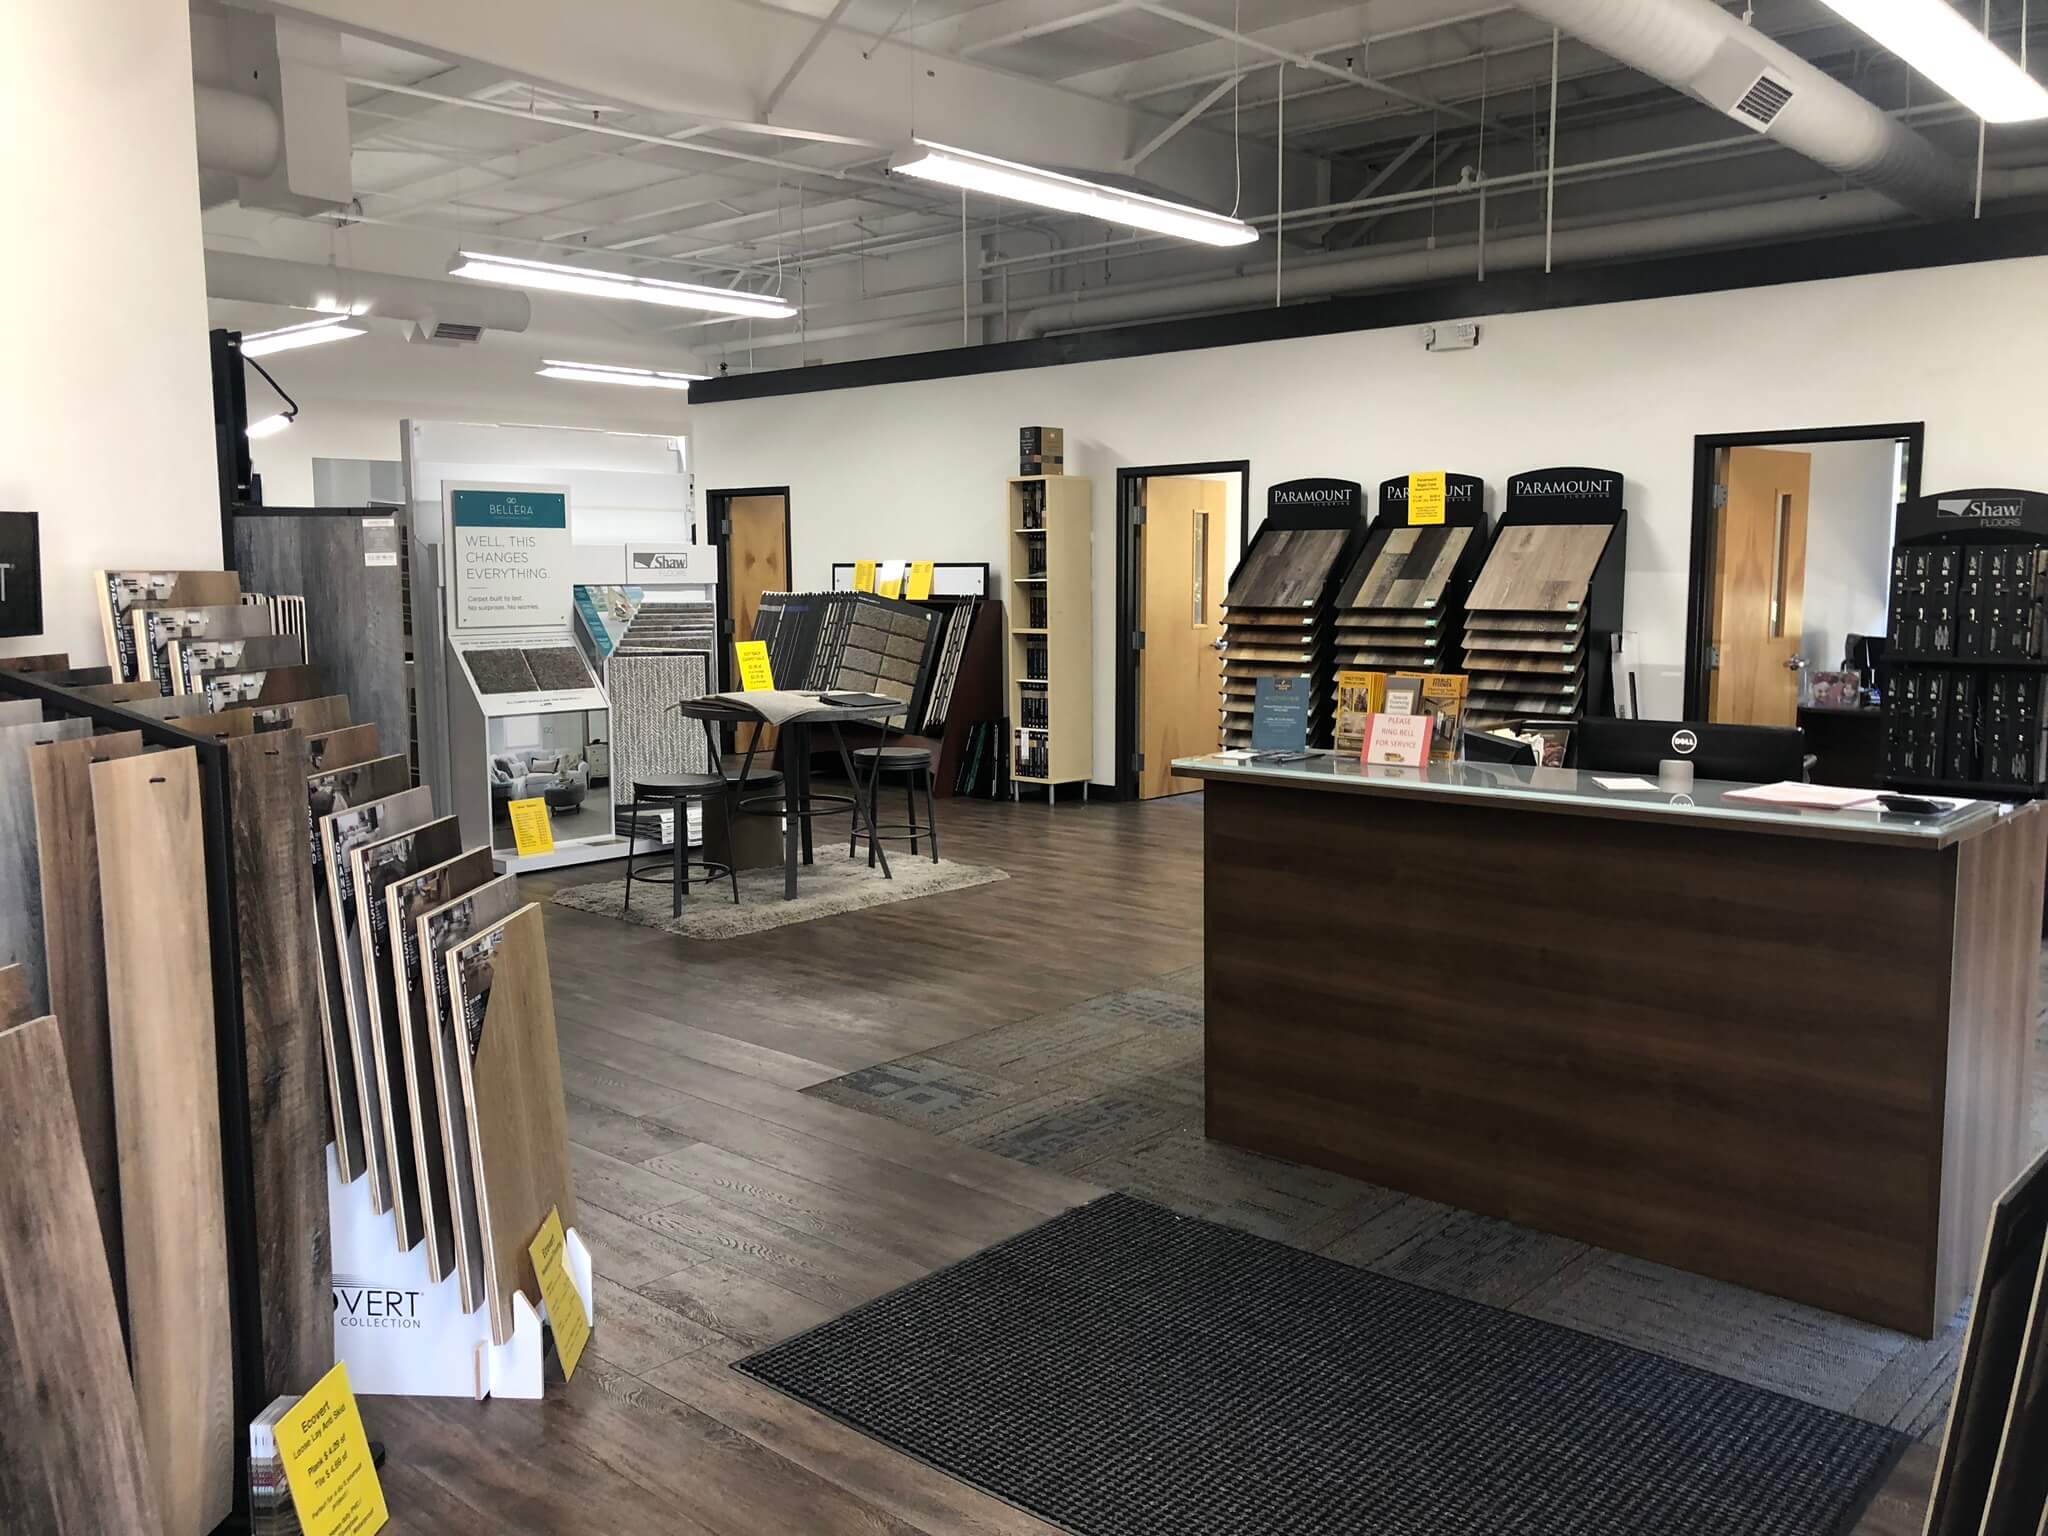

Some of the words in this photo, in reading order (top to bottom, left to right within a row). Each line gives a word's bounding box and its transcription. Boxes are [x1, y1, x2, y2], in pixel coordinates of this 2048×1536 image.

[1387, 484, 1474, 499] PARUNT
[1516, 479, 1613, 495] PARAMOUNT
[1274, 489, 1353, 503] PARAMOUNT
[489, 504, 534, 515] BELLERA
[1969, 501, 2020, 517] Shaw
[465, 535, 505, 549] WELL,
[509, 535, 536, 548] THIS
[465, 552, 529, 563] CHANGES
[654, 555, 686, 569] Shaw
[109, 580, 130, 677] SPLENDOR
[1388, 716, 1411, 725] PLEASE
[1381, 728, 1398, 736] RING
[1399, 729, 1414, 737] BELL
[1375, 740, 1389, 748] FOR
[1390, 741, 1416, 749] SERVICE
[1674, 737, 1694, 746] DELL
[335, 842, 347, 900] GRAND
[364, 862, 381, 957] MAJESTIC
[398, 896, 413, 992] MAJESTIC
[341, 1317, 421, 1328] COLLECTION
[300, 1401, 330, 1434] Ecovert
